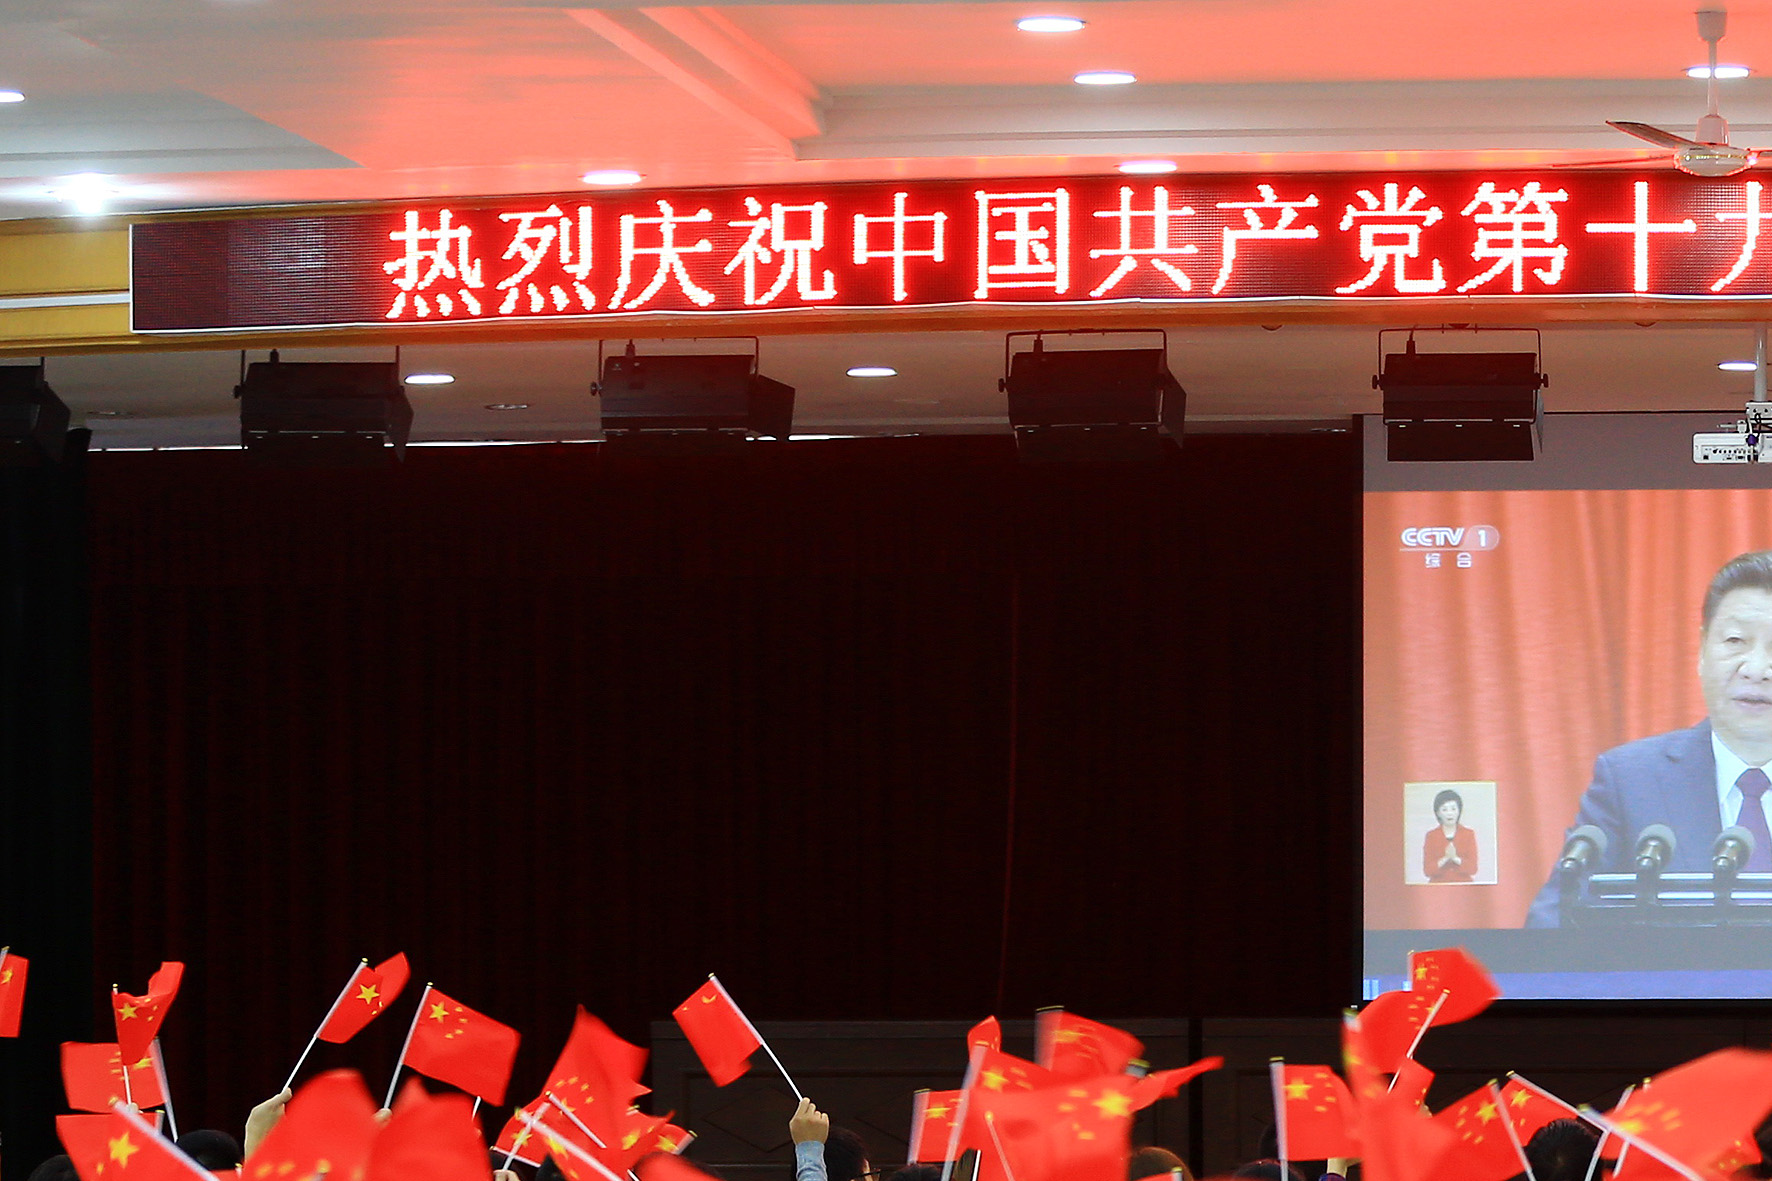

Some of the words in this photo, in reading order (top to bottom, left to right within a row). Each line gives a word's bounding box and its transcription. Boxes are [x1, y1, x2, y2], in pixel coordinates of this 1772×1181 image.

[1401, 527, 1465, 547] CCTV
[1478, 529, 1486, 547] 1
[1425, 552, 1471, 568] 综合
